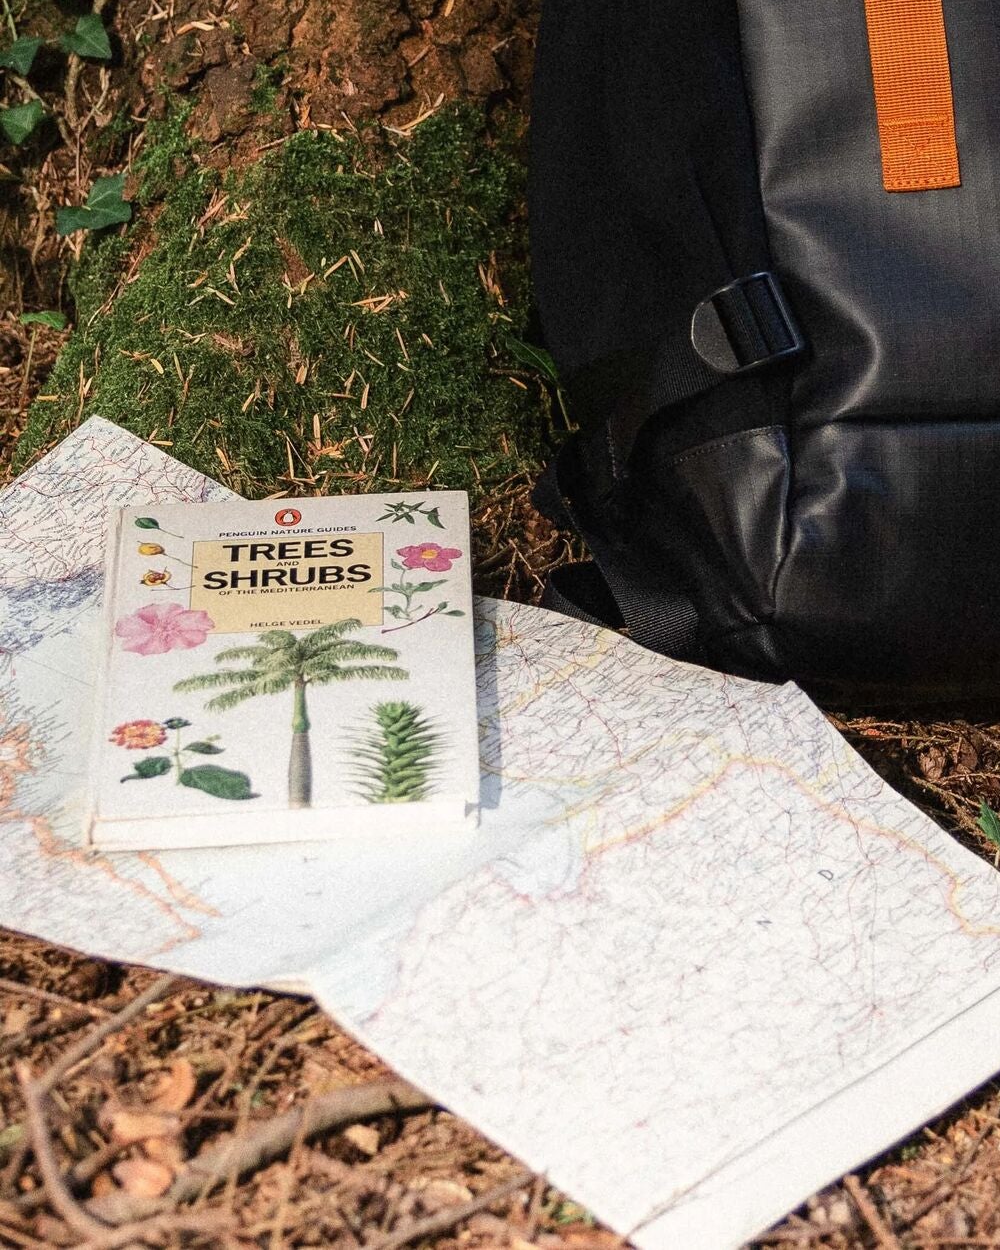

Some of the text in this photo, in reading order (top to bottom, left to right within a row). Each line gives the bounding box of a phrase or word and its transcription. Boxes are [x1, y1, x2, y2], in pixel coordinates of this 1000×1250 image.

[218, 525, 357, 538] PENGUIN NATURE GUIDES
[222, 538, 354, 562] TREES
[203, 564, 372, 590] SHRUBS
[260, 584, 355, 594] MEDITERRANEAN
[250, 620, 286, 628] HELGE
